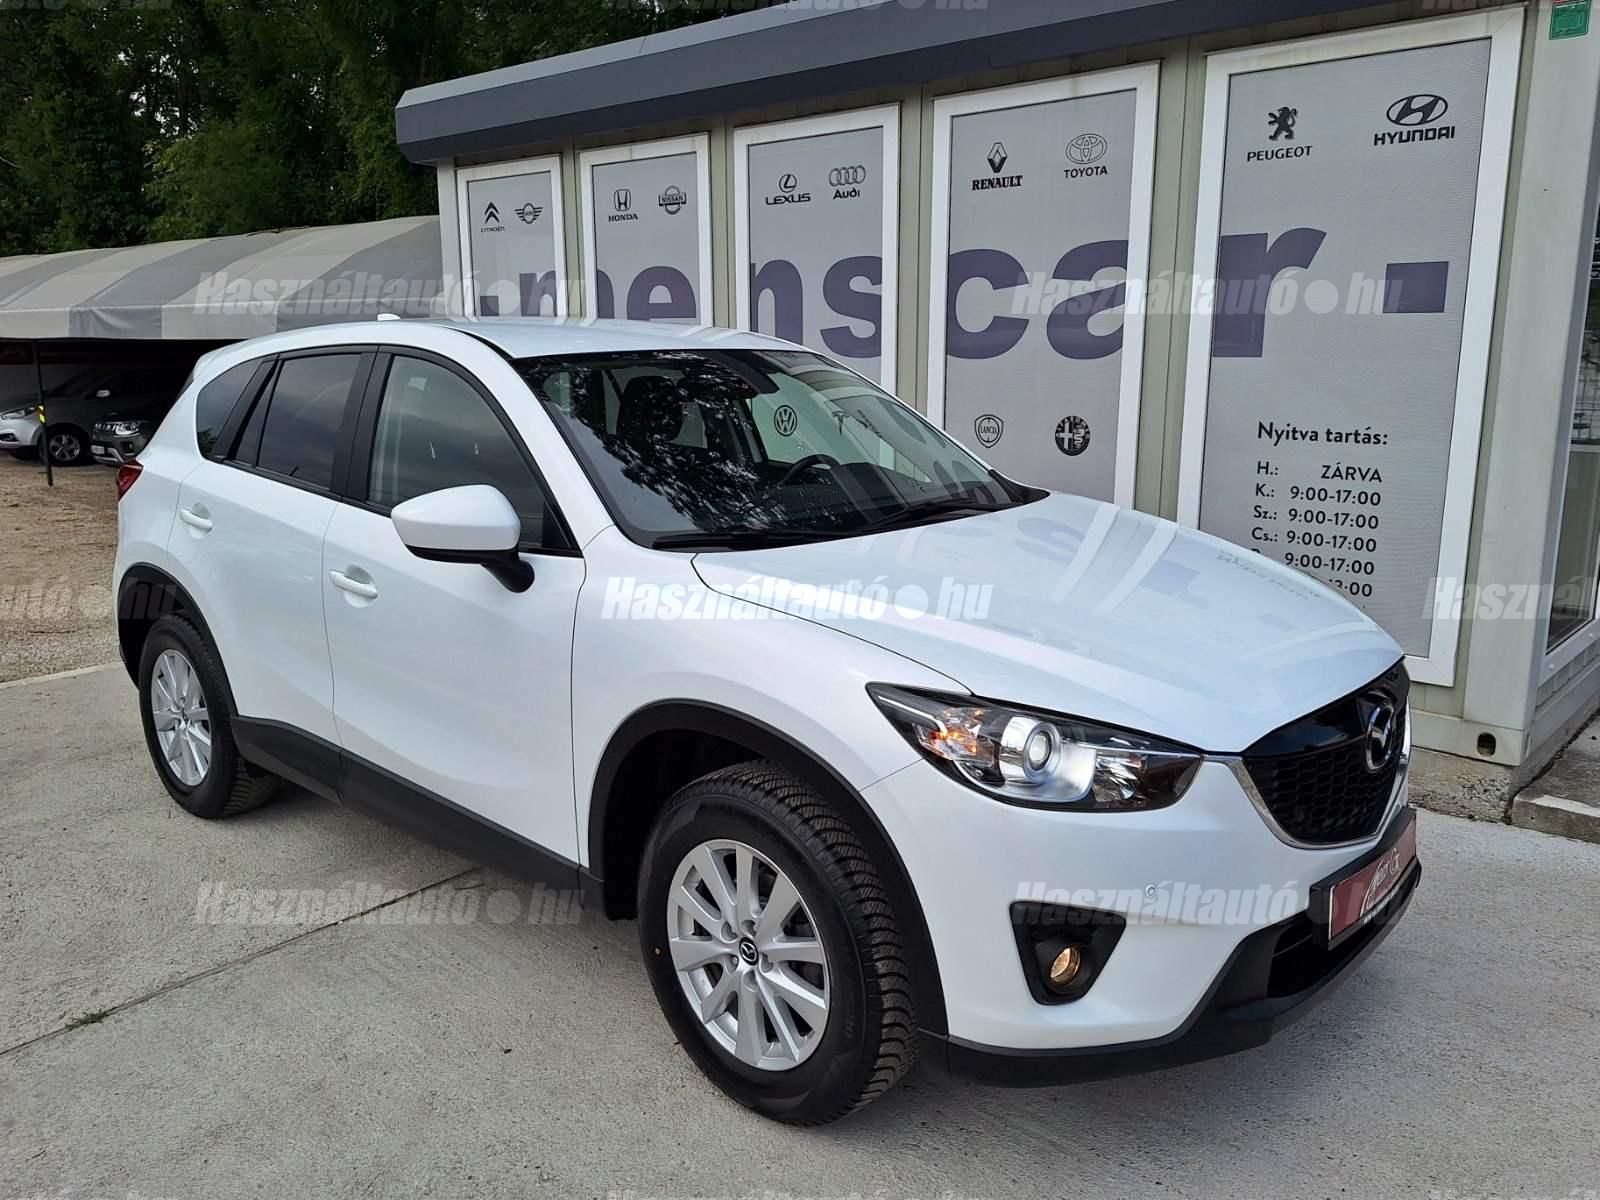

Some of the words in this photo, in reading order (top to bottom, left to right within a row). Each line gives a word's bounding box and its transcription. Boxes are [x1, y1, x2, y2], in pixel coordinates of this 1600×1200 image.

[1373, 125, 1455, 146] HYUNDAI
[1246, 145, 1313, 162] PEUGEOT
[1063, 165, 1109, 179] TOYOTA
[971, 175, 1024, 191] RENAULT
[661, 194, 685, 204] NISSAN
[765, 192, 811, 206] LEXUS
[833, 189, 861, 200] Audi
[608, 213, 639, 223] HONDA
[1257, 421, 1319, 447] Nyitva
[1325, 426, 1388, 446] tartás:
[1257, 461, 1279, 476] H.:
[1320, 462, 1383, 484] ZÁRVA
[1255, 482, 1275, 498] K.:
[1290, 485, 1381, 506] 9:00-17:00
[1253, 505, 1278, 520] Sz.:
[1288, 508, 1379, 530] 9:00-17:00
[1251, 526, 1279, 542] Cs.:
[1286, 530, 1377, 553] 9:00-17:00
[1284, 552, 1375, 576] 9:00-17:00
